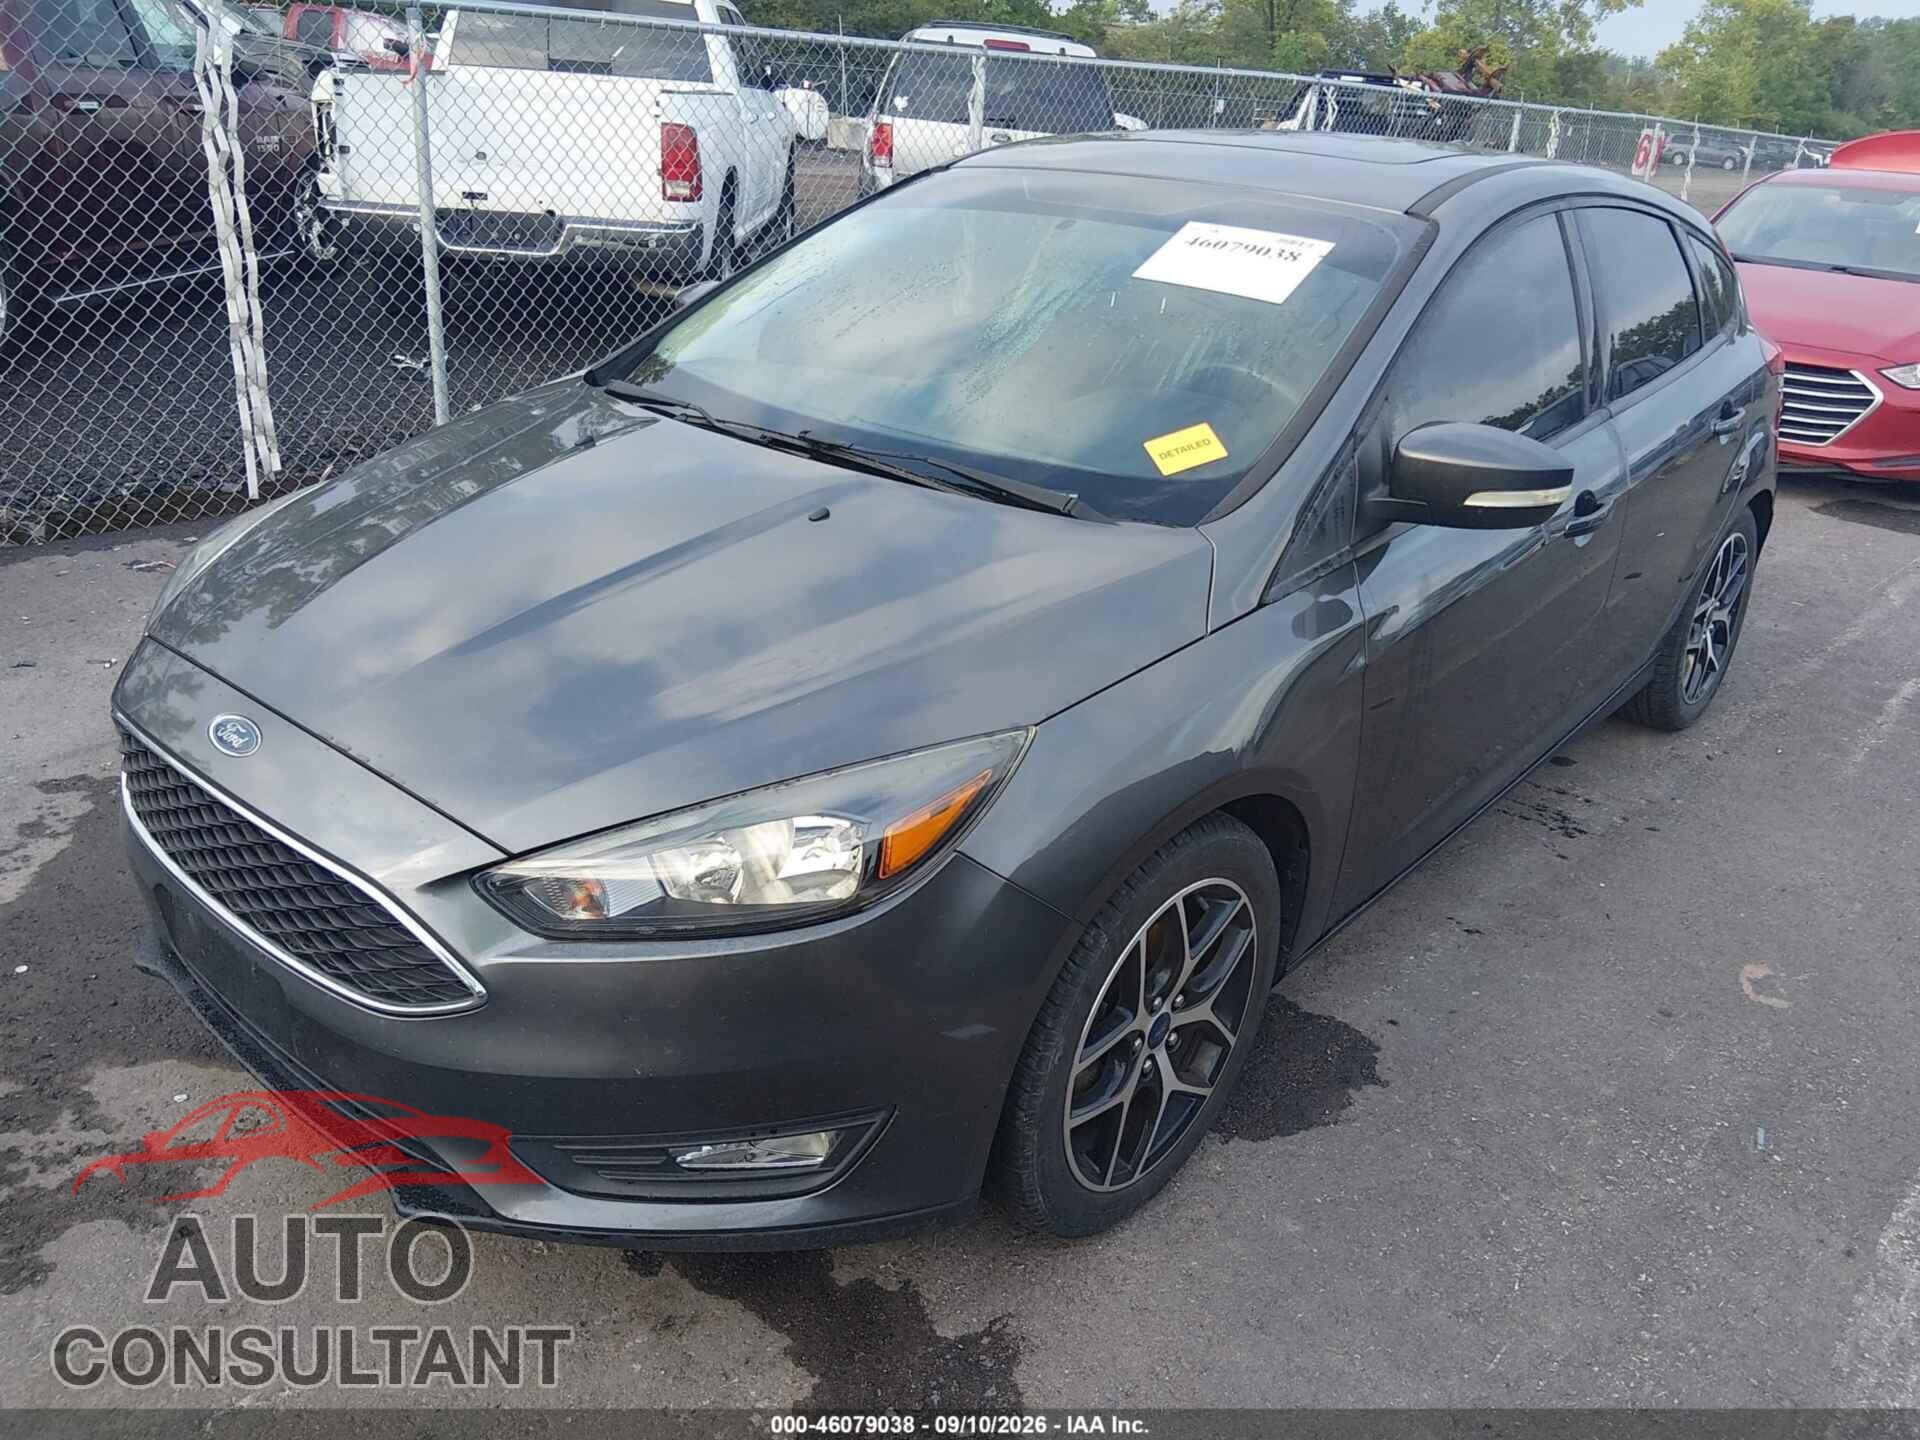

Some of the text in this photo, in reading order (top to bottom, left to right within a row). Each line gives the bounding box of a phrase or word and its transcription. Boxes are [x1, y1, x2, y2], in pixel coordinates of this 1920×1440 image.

[1187, 236, 1302, 262] 46079038
[1159, 438, 1211, 460] DETAILED
[216, 722, 249, 748] Ford
